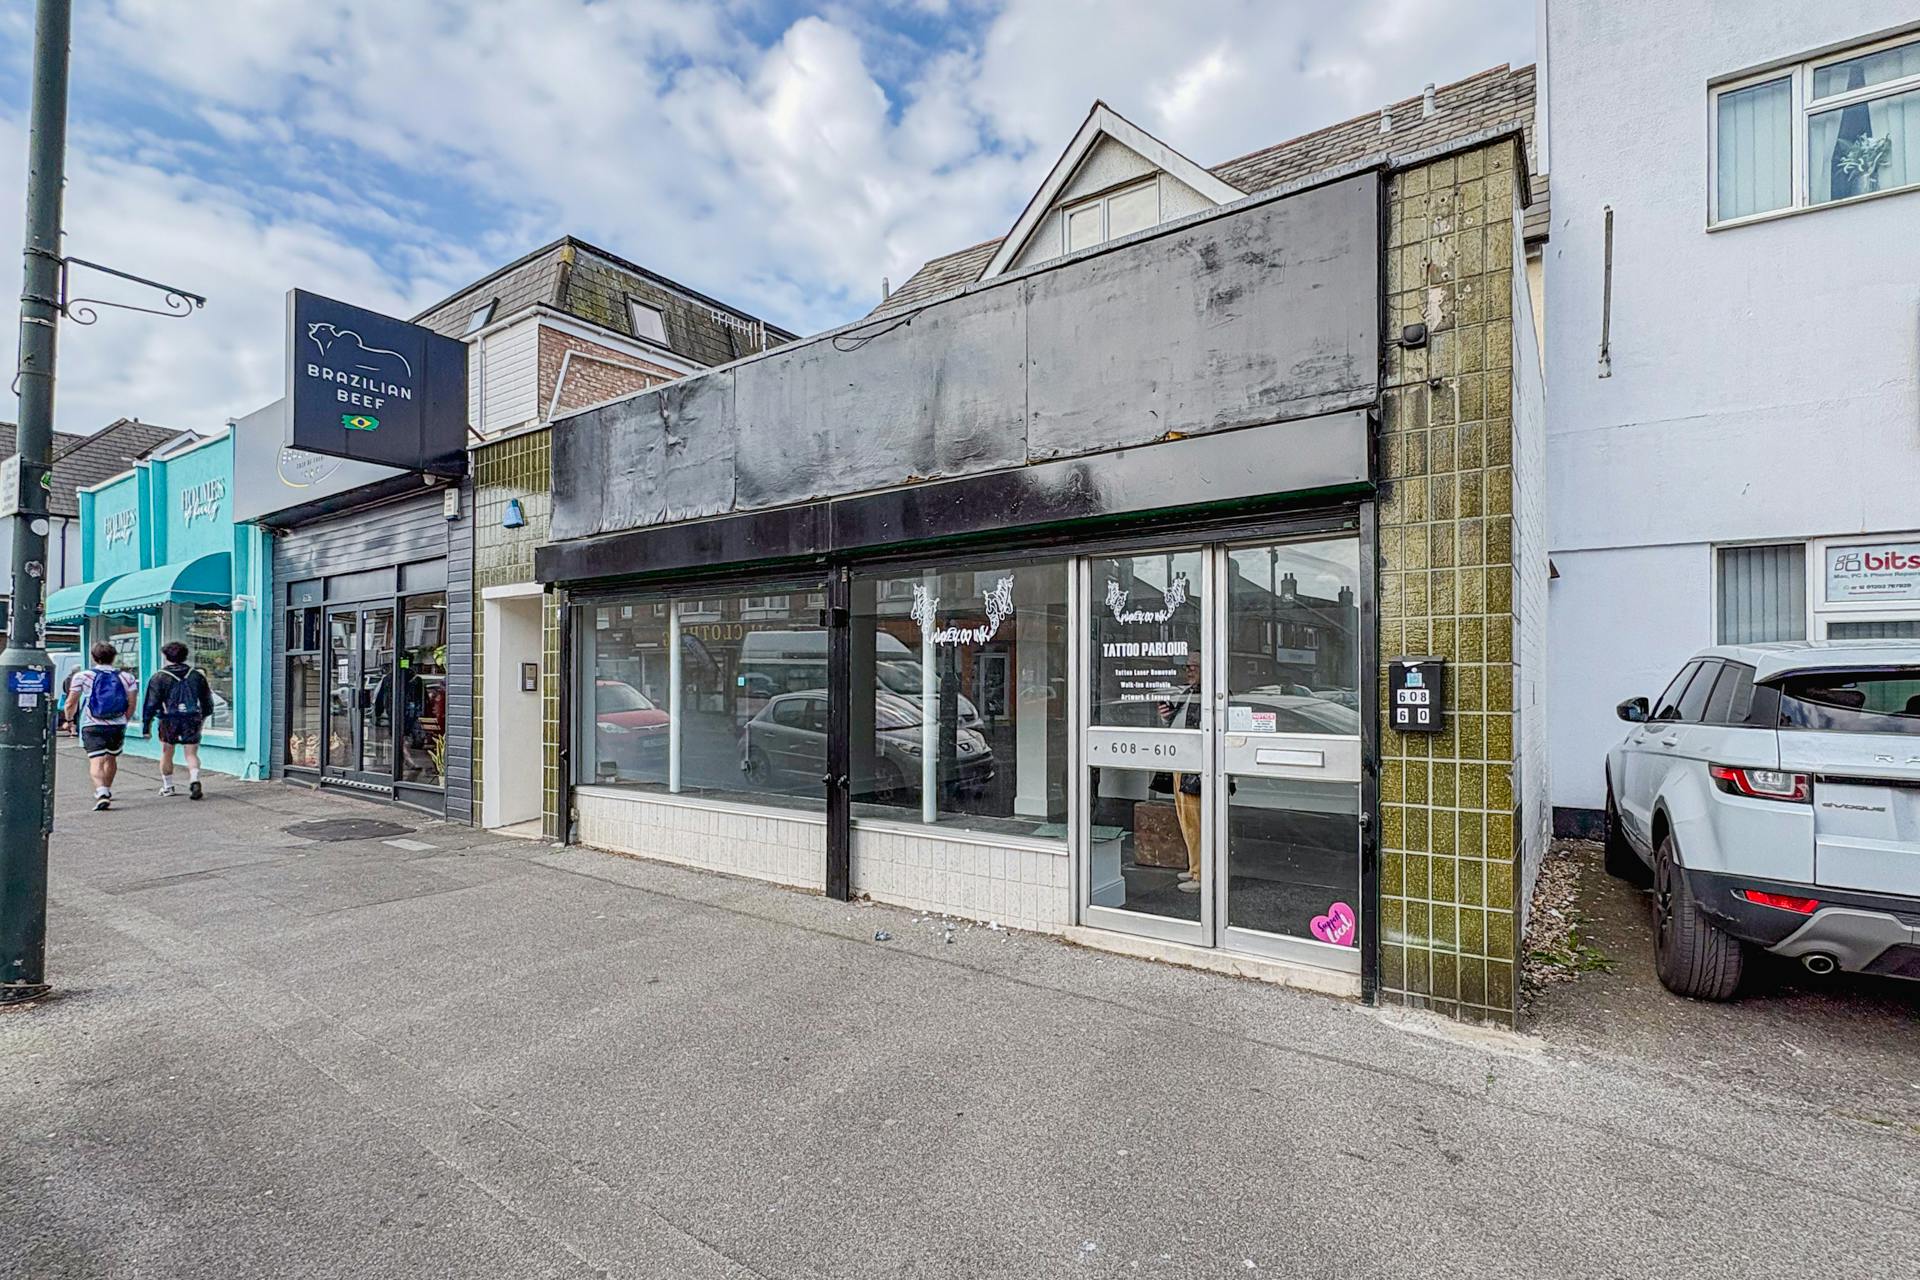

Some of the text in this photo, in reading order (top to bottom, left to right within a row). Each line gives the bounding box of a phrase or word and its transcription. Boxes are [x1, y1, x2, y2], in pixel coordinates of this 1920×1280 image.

[307, 364, 412, 400] BRAZILIAN
[337, 388, 385, 411] BEEF
[182, 477, 226, 511] HOLMES
[1864, 551, 1920, 571] bits
[1103, 641, 1188, 658] TATTOO PARLOUR
[1145, 681, 1171, 689] Available
[1399, 691, 1427, 702] 608
